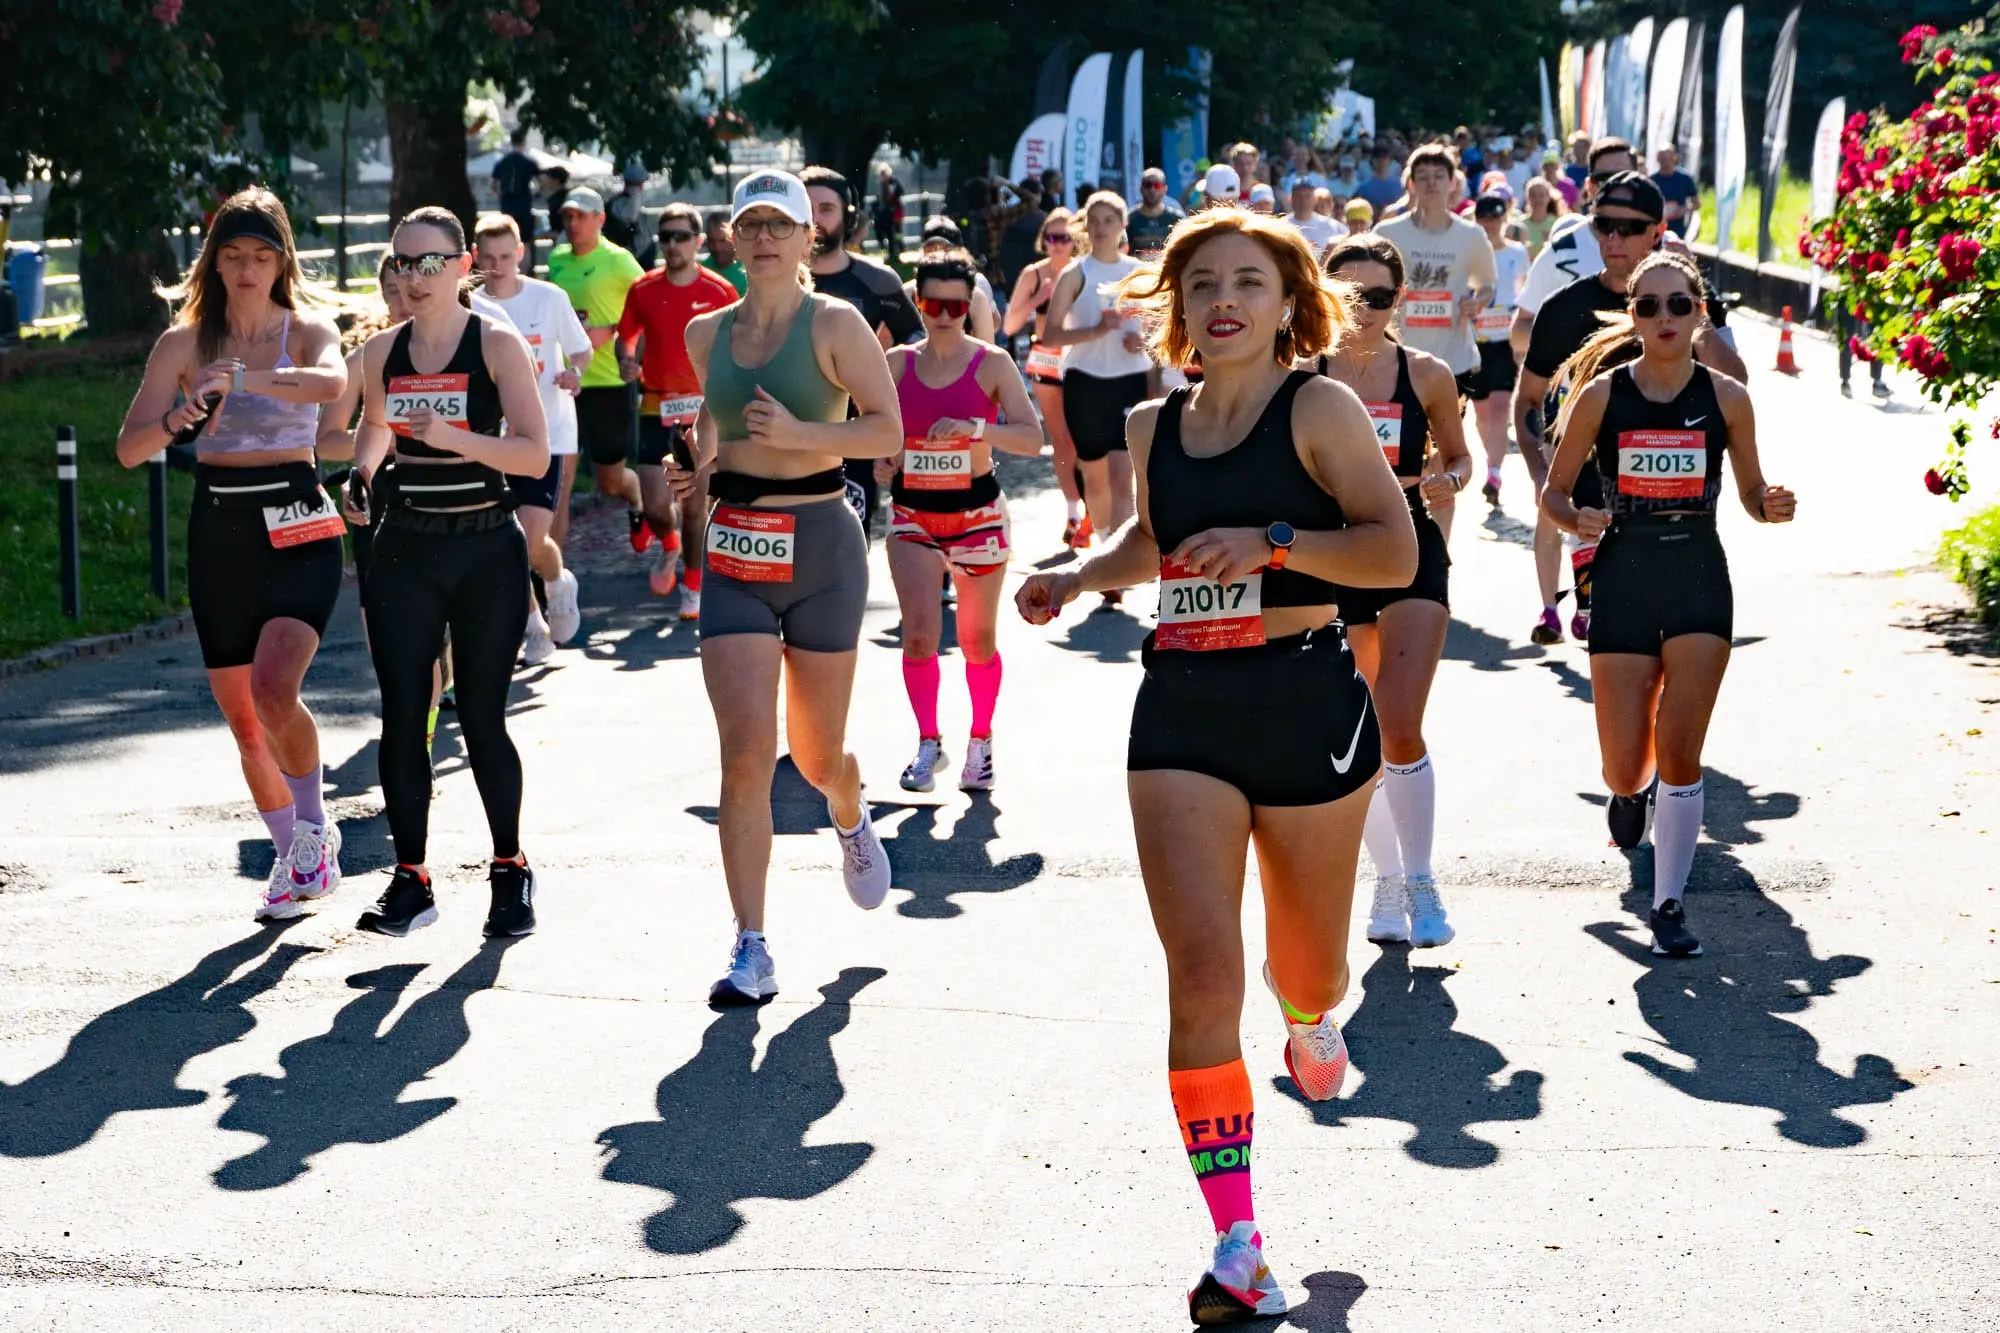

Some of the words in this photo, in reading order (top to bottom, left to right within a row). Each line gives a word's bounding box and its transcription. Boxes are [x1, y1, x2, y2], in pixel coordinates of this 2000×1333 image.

[913, 455, 963, 471] 21160
[1630, 454, 1696, 473] 21013
[716, 531, 788, 558] 21006
[1172, 583, 1248, 615] 21017
